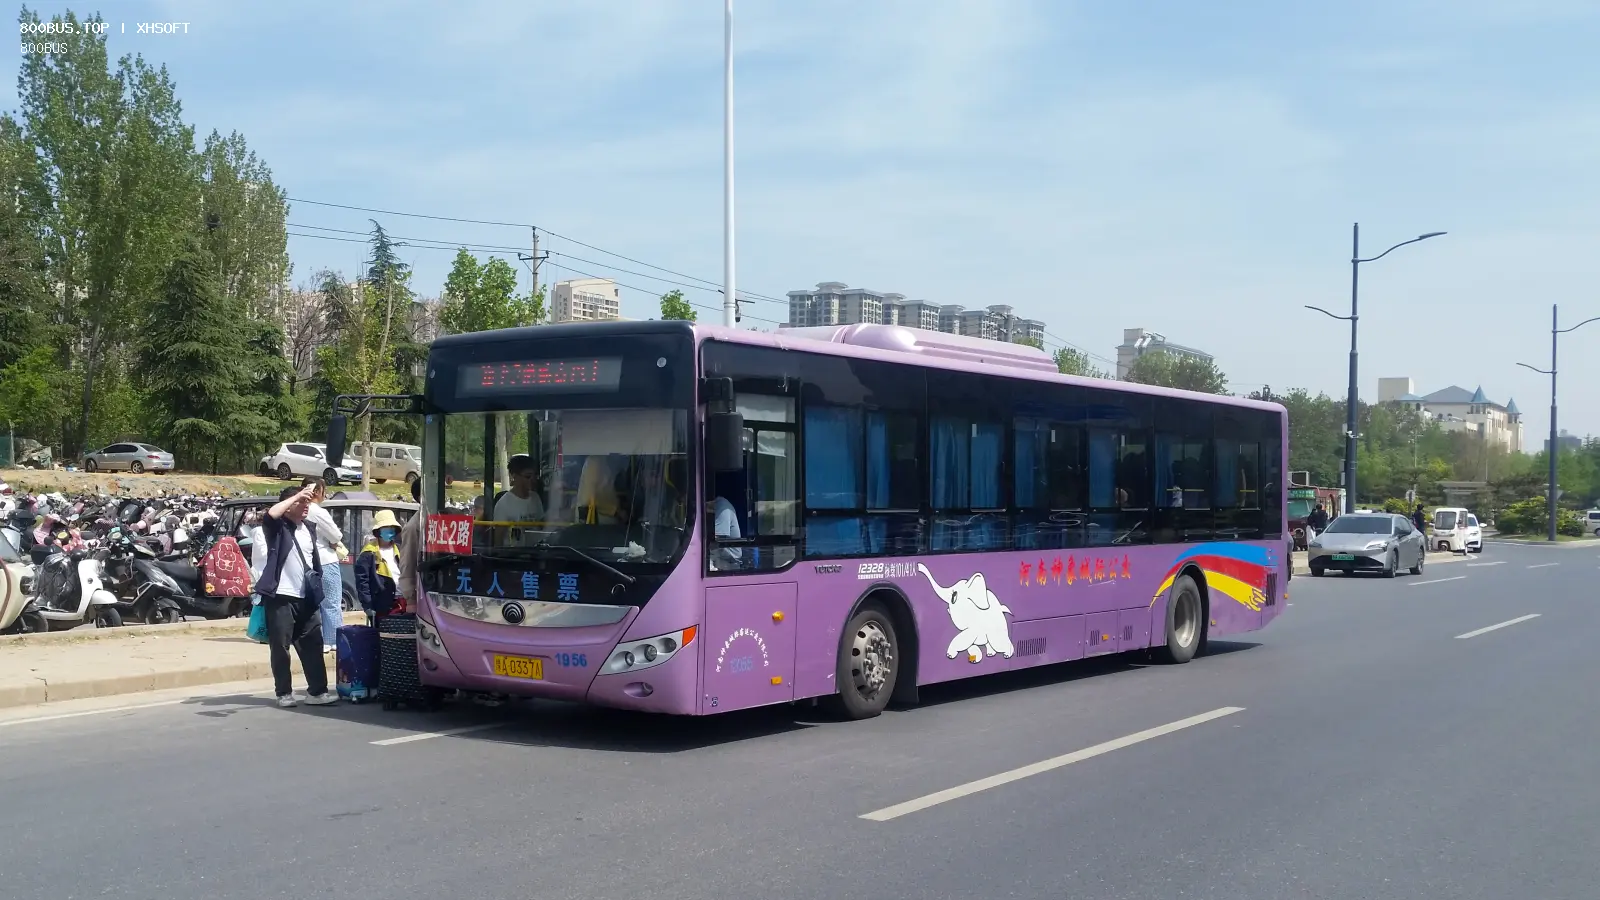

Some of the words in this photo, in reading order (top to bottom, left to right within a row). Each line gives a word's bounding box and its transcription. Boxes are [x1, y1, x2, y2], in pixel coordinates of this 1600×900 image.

[427, 519, 470, 547] 郑上2路
[858, 563, 884, 573] 12328
[456, 568, 580, 601] 无人售票
[555, 652, 588, 667] 1956
